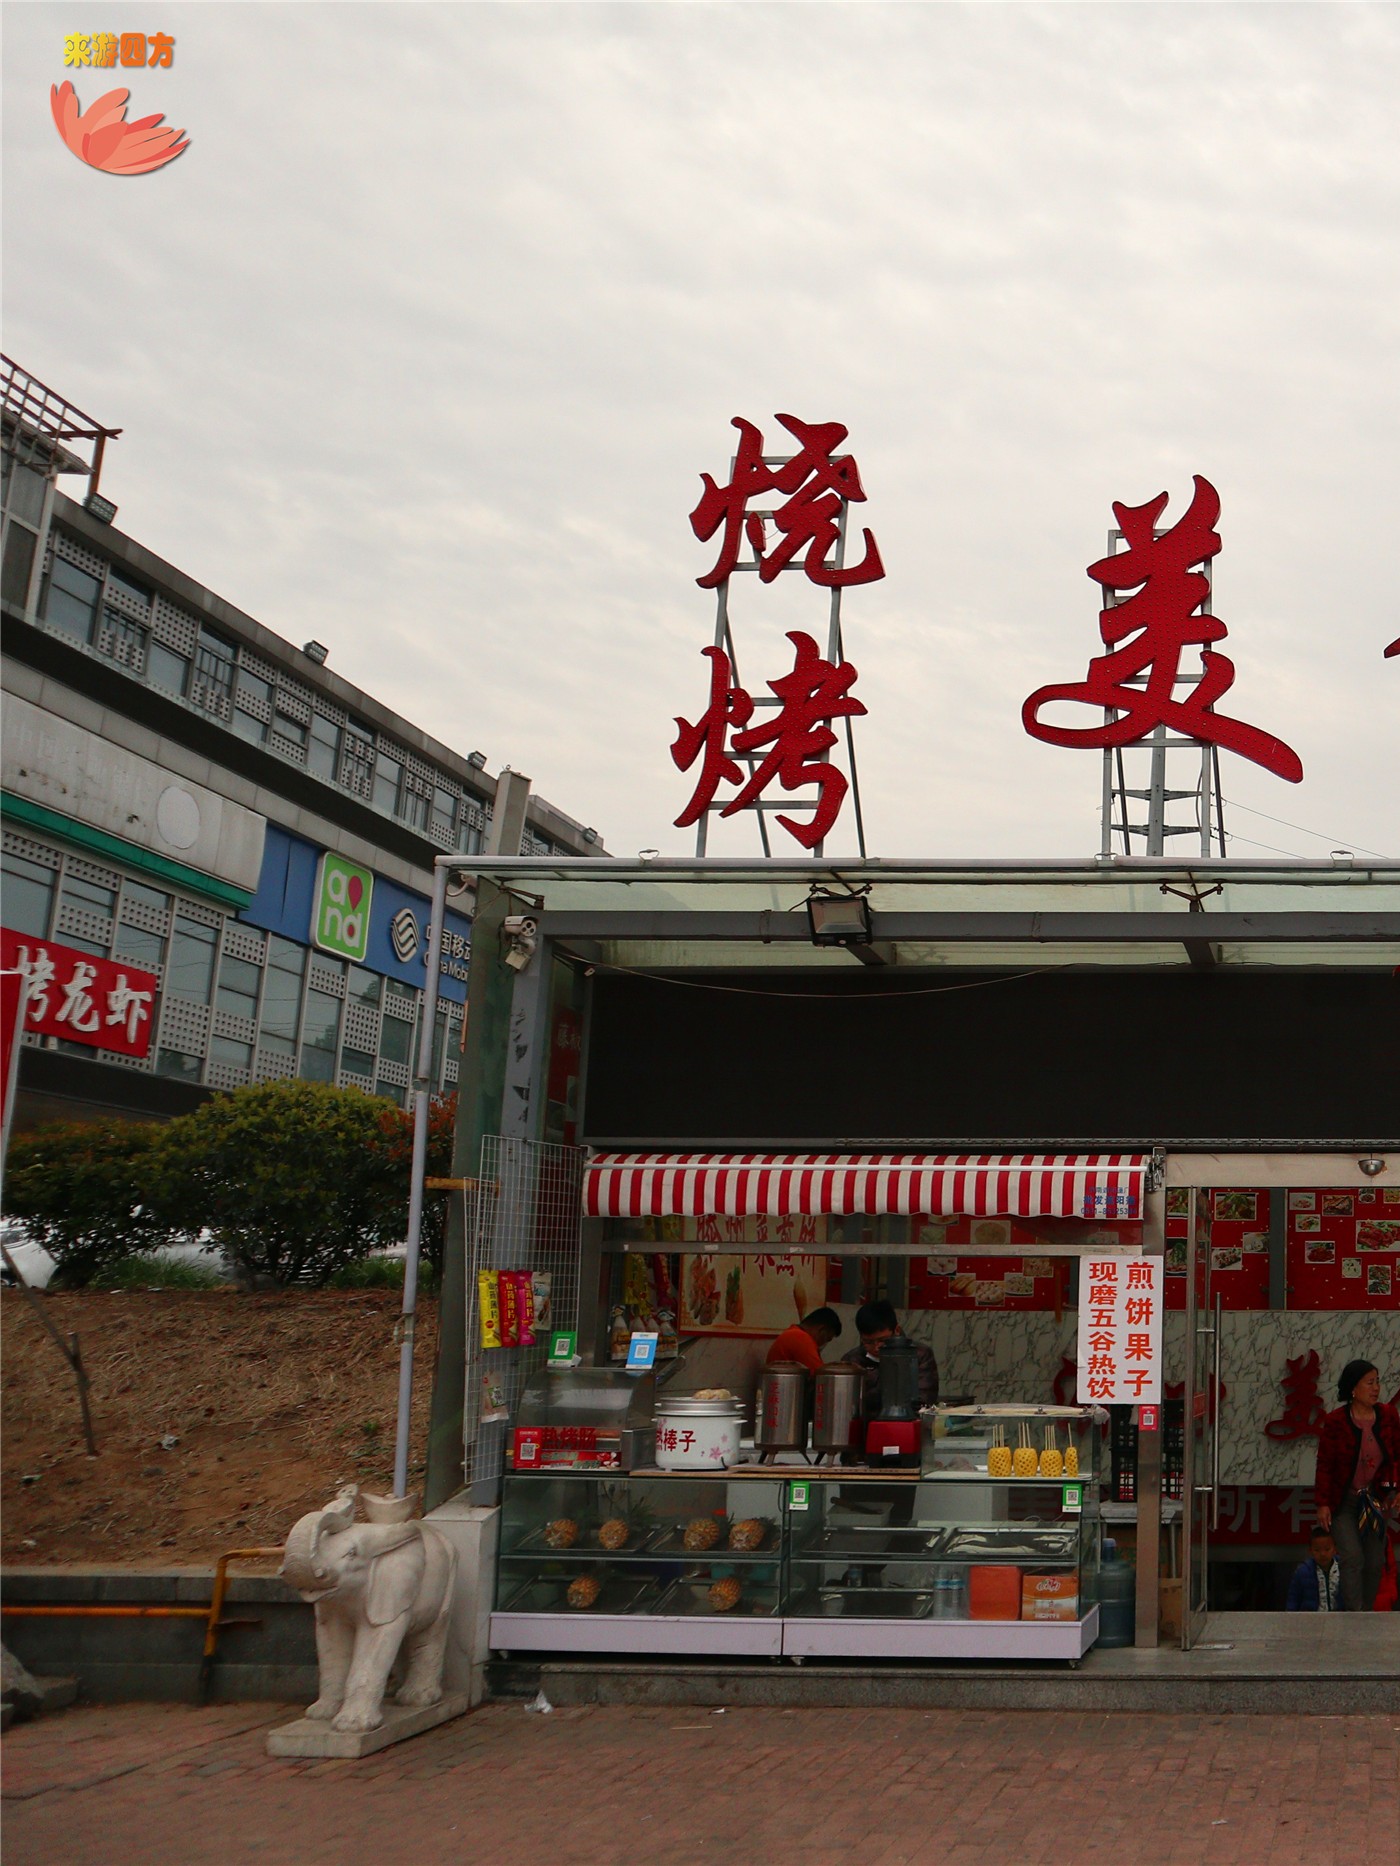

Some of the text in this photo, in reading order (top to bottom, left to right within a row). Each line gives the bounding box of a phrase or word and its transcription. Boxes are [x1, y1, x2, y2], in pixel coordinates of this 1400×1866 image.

[670, 413, 886, 850] 烧烤
[1087, 1261, 1118, 1398] 现磨五谷热饮
[1123, 1261, 1155, 1397] 煎饼果子
